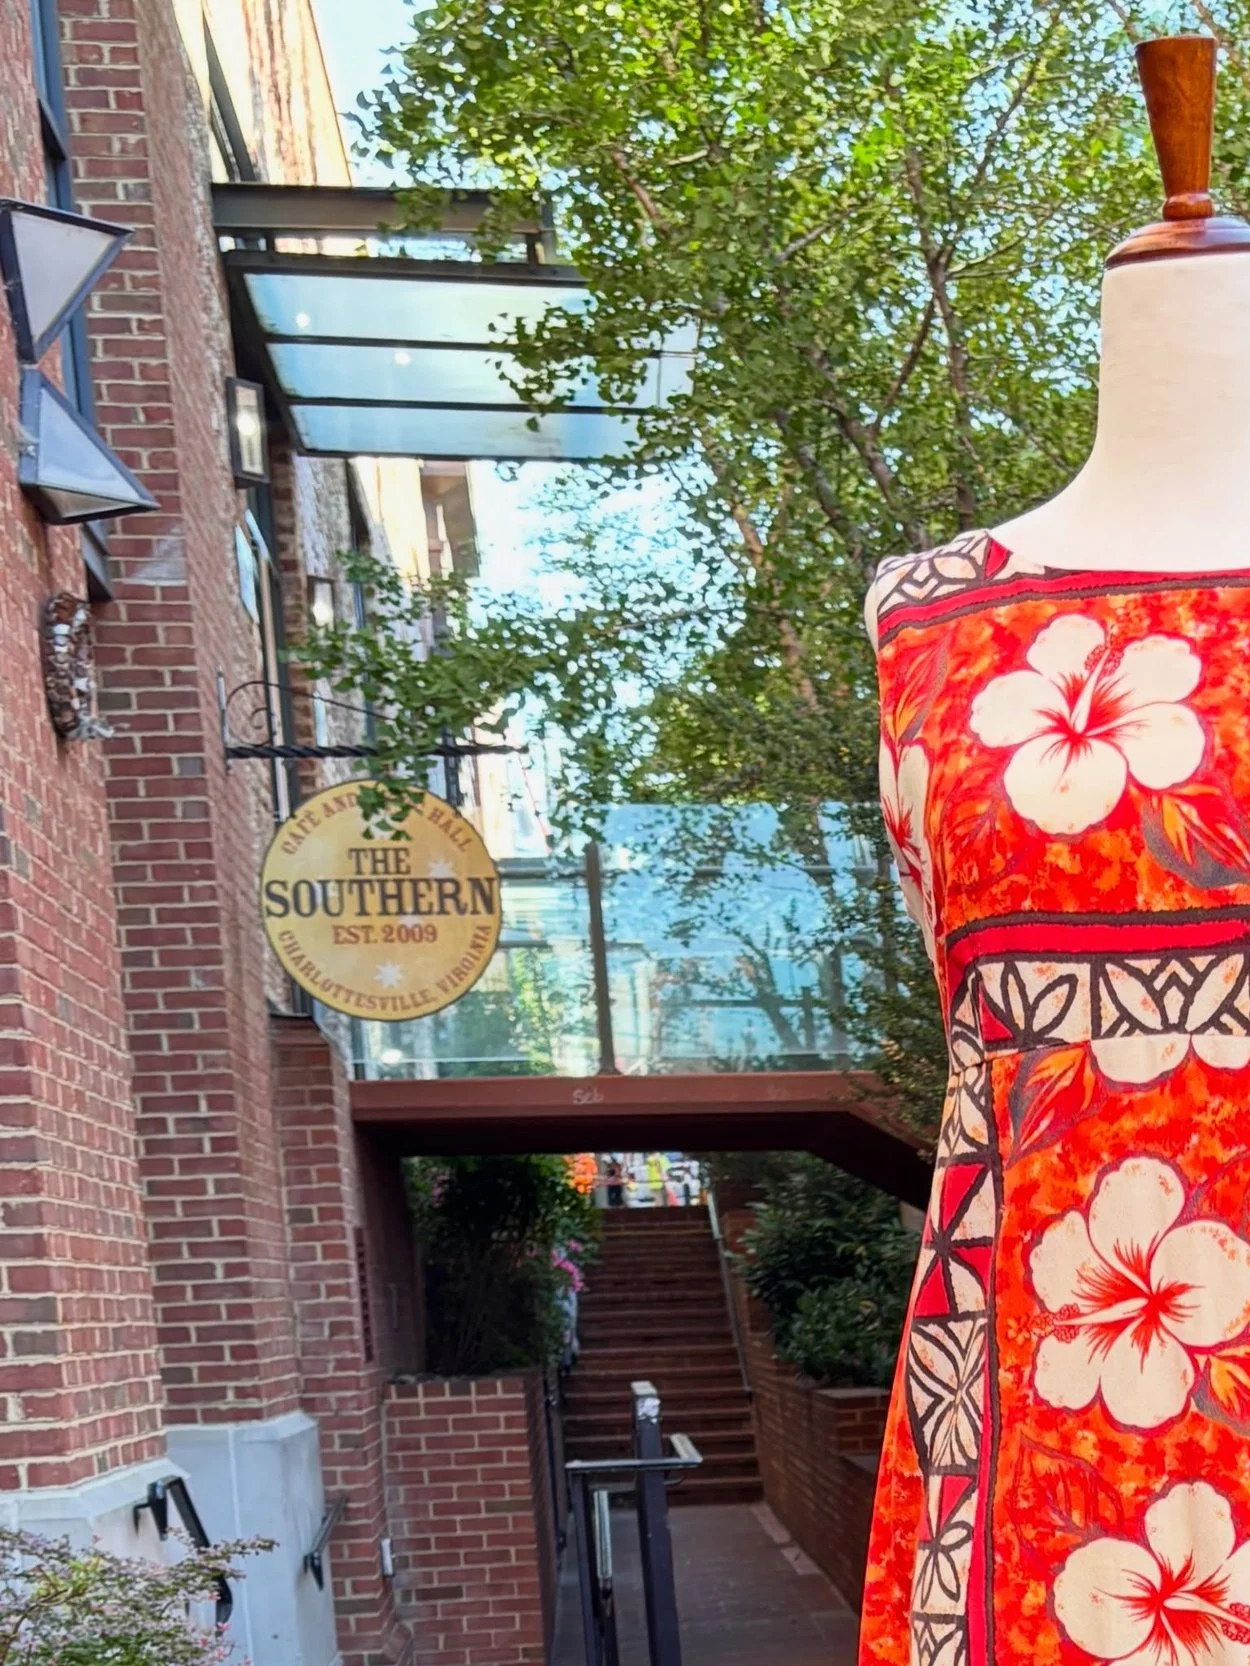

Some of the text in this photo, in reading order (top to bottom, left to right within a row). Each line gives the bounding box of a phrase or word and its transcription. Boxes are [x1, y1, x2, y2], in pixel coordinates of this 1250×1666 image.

[427, 806, 473, 854] HALL
[347, 847, 411, 876] THE
[264, 877, 498, 918] SOUTHERN
[332, 923, 438, 945] EST. 2009
